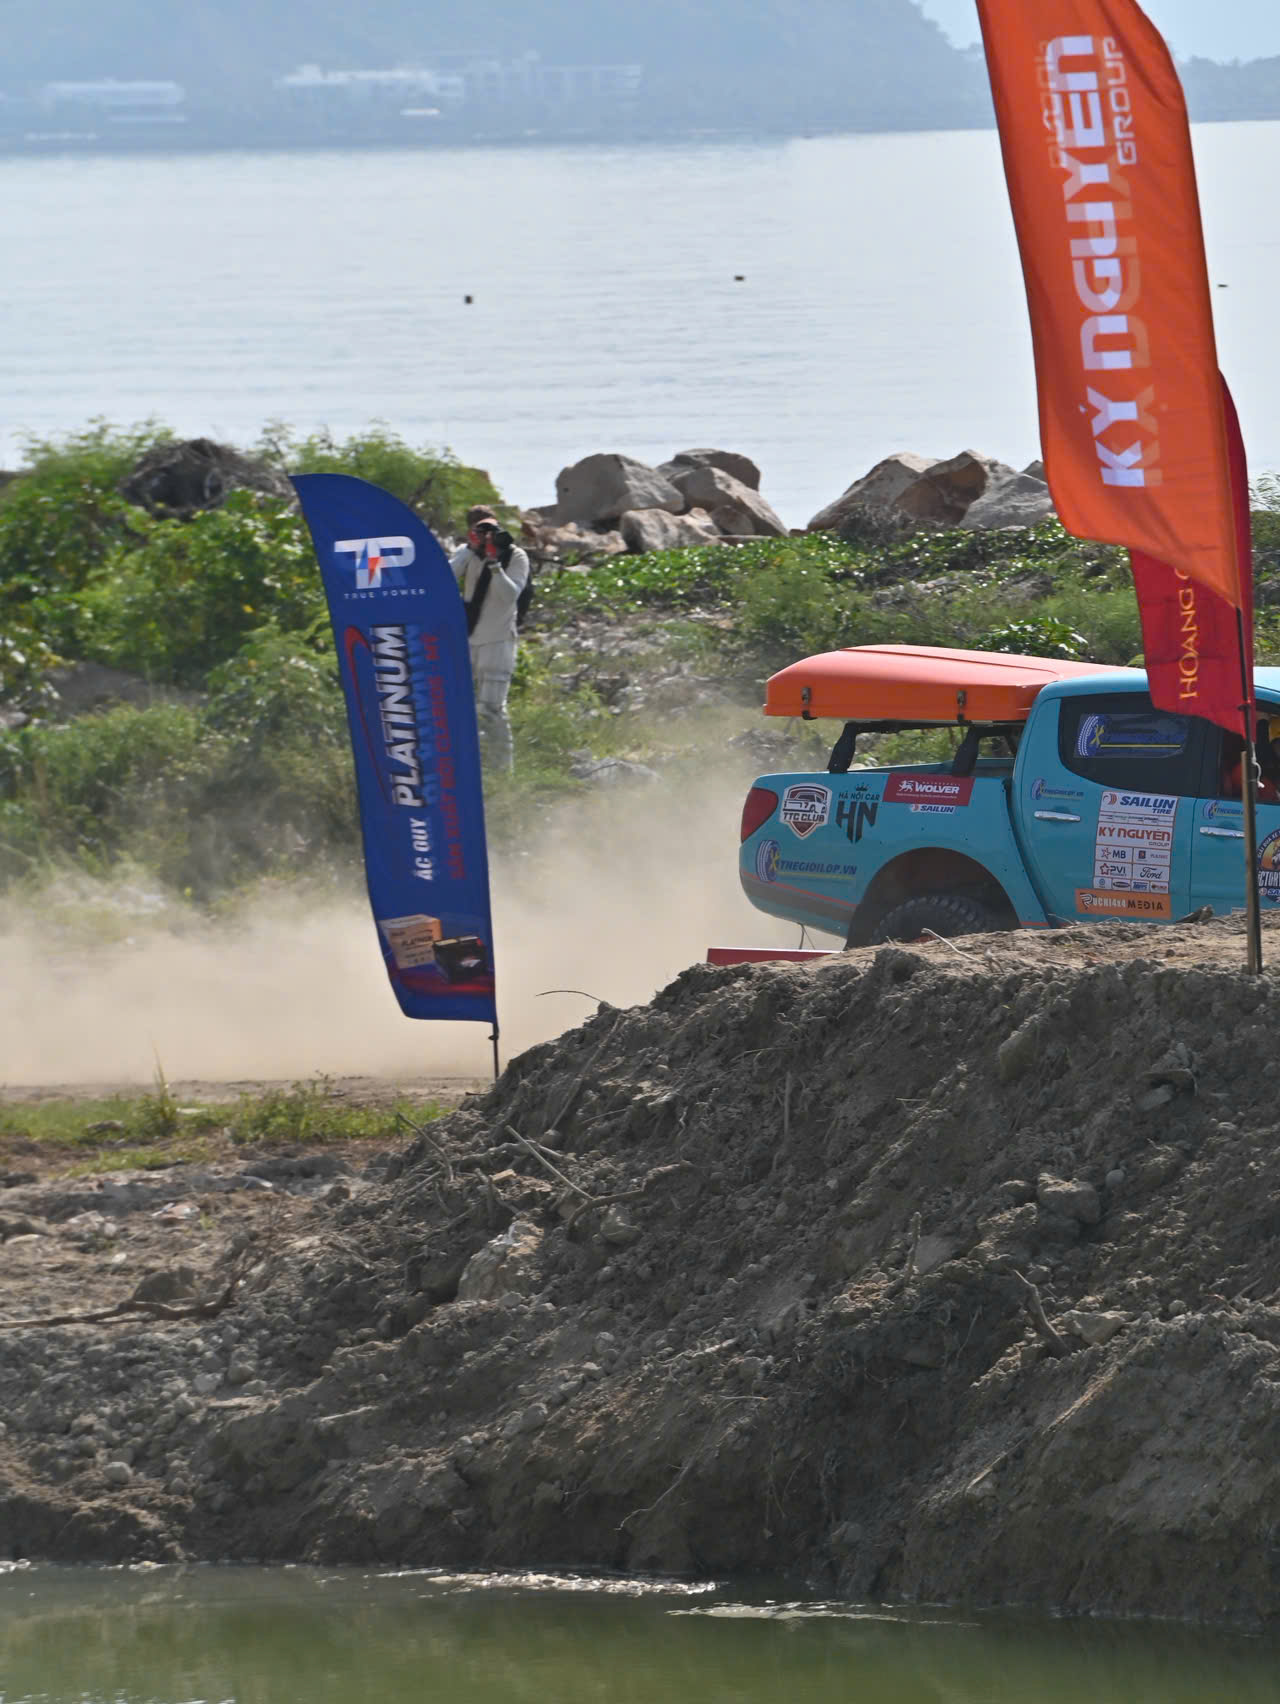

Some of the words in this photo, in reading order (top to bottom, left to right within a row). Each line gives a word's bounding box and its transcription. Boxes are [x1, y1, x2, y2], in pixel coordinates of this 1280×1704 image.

[1103, 37, 1137, 165] GROUP
[370, 624, 425, 807] PLATINUM
[915, 783, 960, 794] WOLVER
[865, 793, 880, 801] CAR
[1120, 795, 1176, 809] SAILUN
[920, 804, 954, 813] SAILUN
[783, 812, 800, 821] TTC
[801, 813, 825, 822] CLUB
[835, 800, 878, 844] HN
[1112, 849, 1126, 859] MB
[1110, 865, 1126, 874] PVI
[1140, 866, 1162, 879] Ford
[1127, 900, 1164, 911] MEDIA
